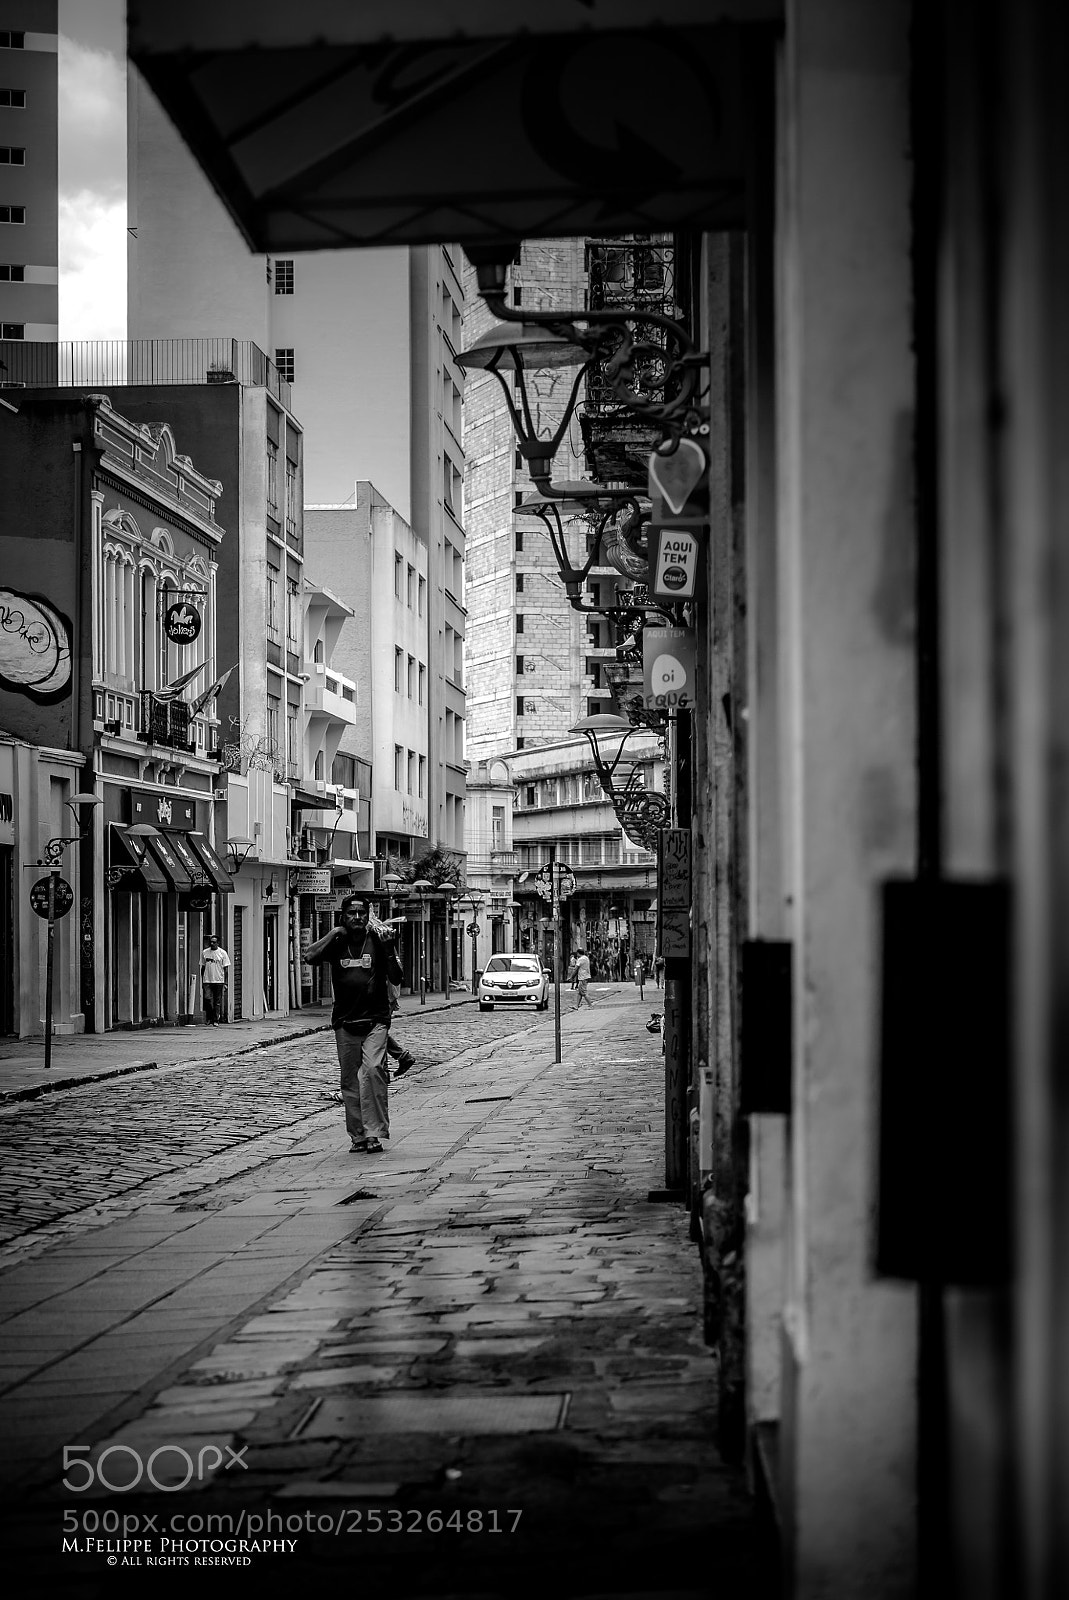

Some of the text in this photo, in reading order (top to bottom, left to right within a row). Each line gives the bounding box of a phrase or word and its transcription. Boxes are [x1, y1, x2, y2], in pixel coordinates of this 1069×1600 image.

[664, 541, 692, 553] AQUI
[663, 552, 687, 564] TEM
[646, 630, 686, 639] AQUI TEM
[662, 669, 675, 683] oi
